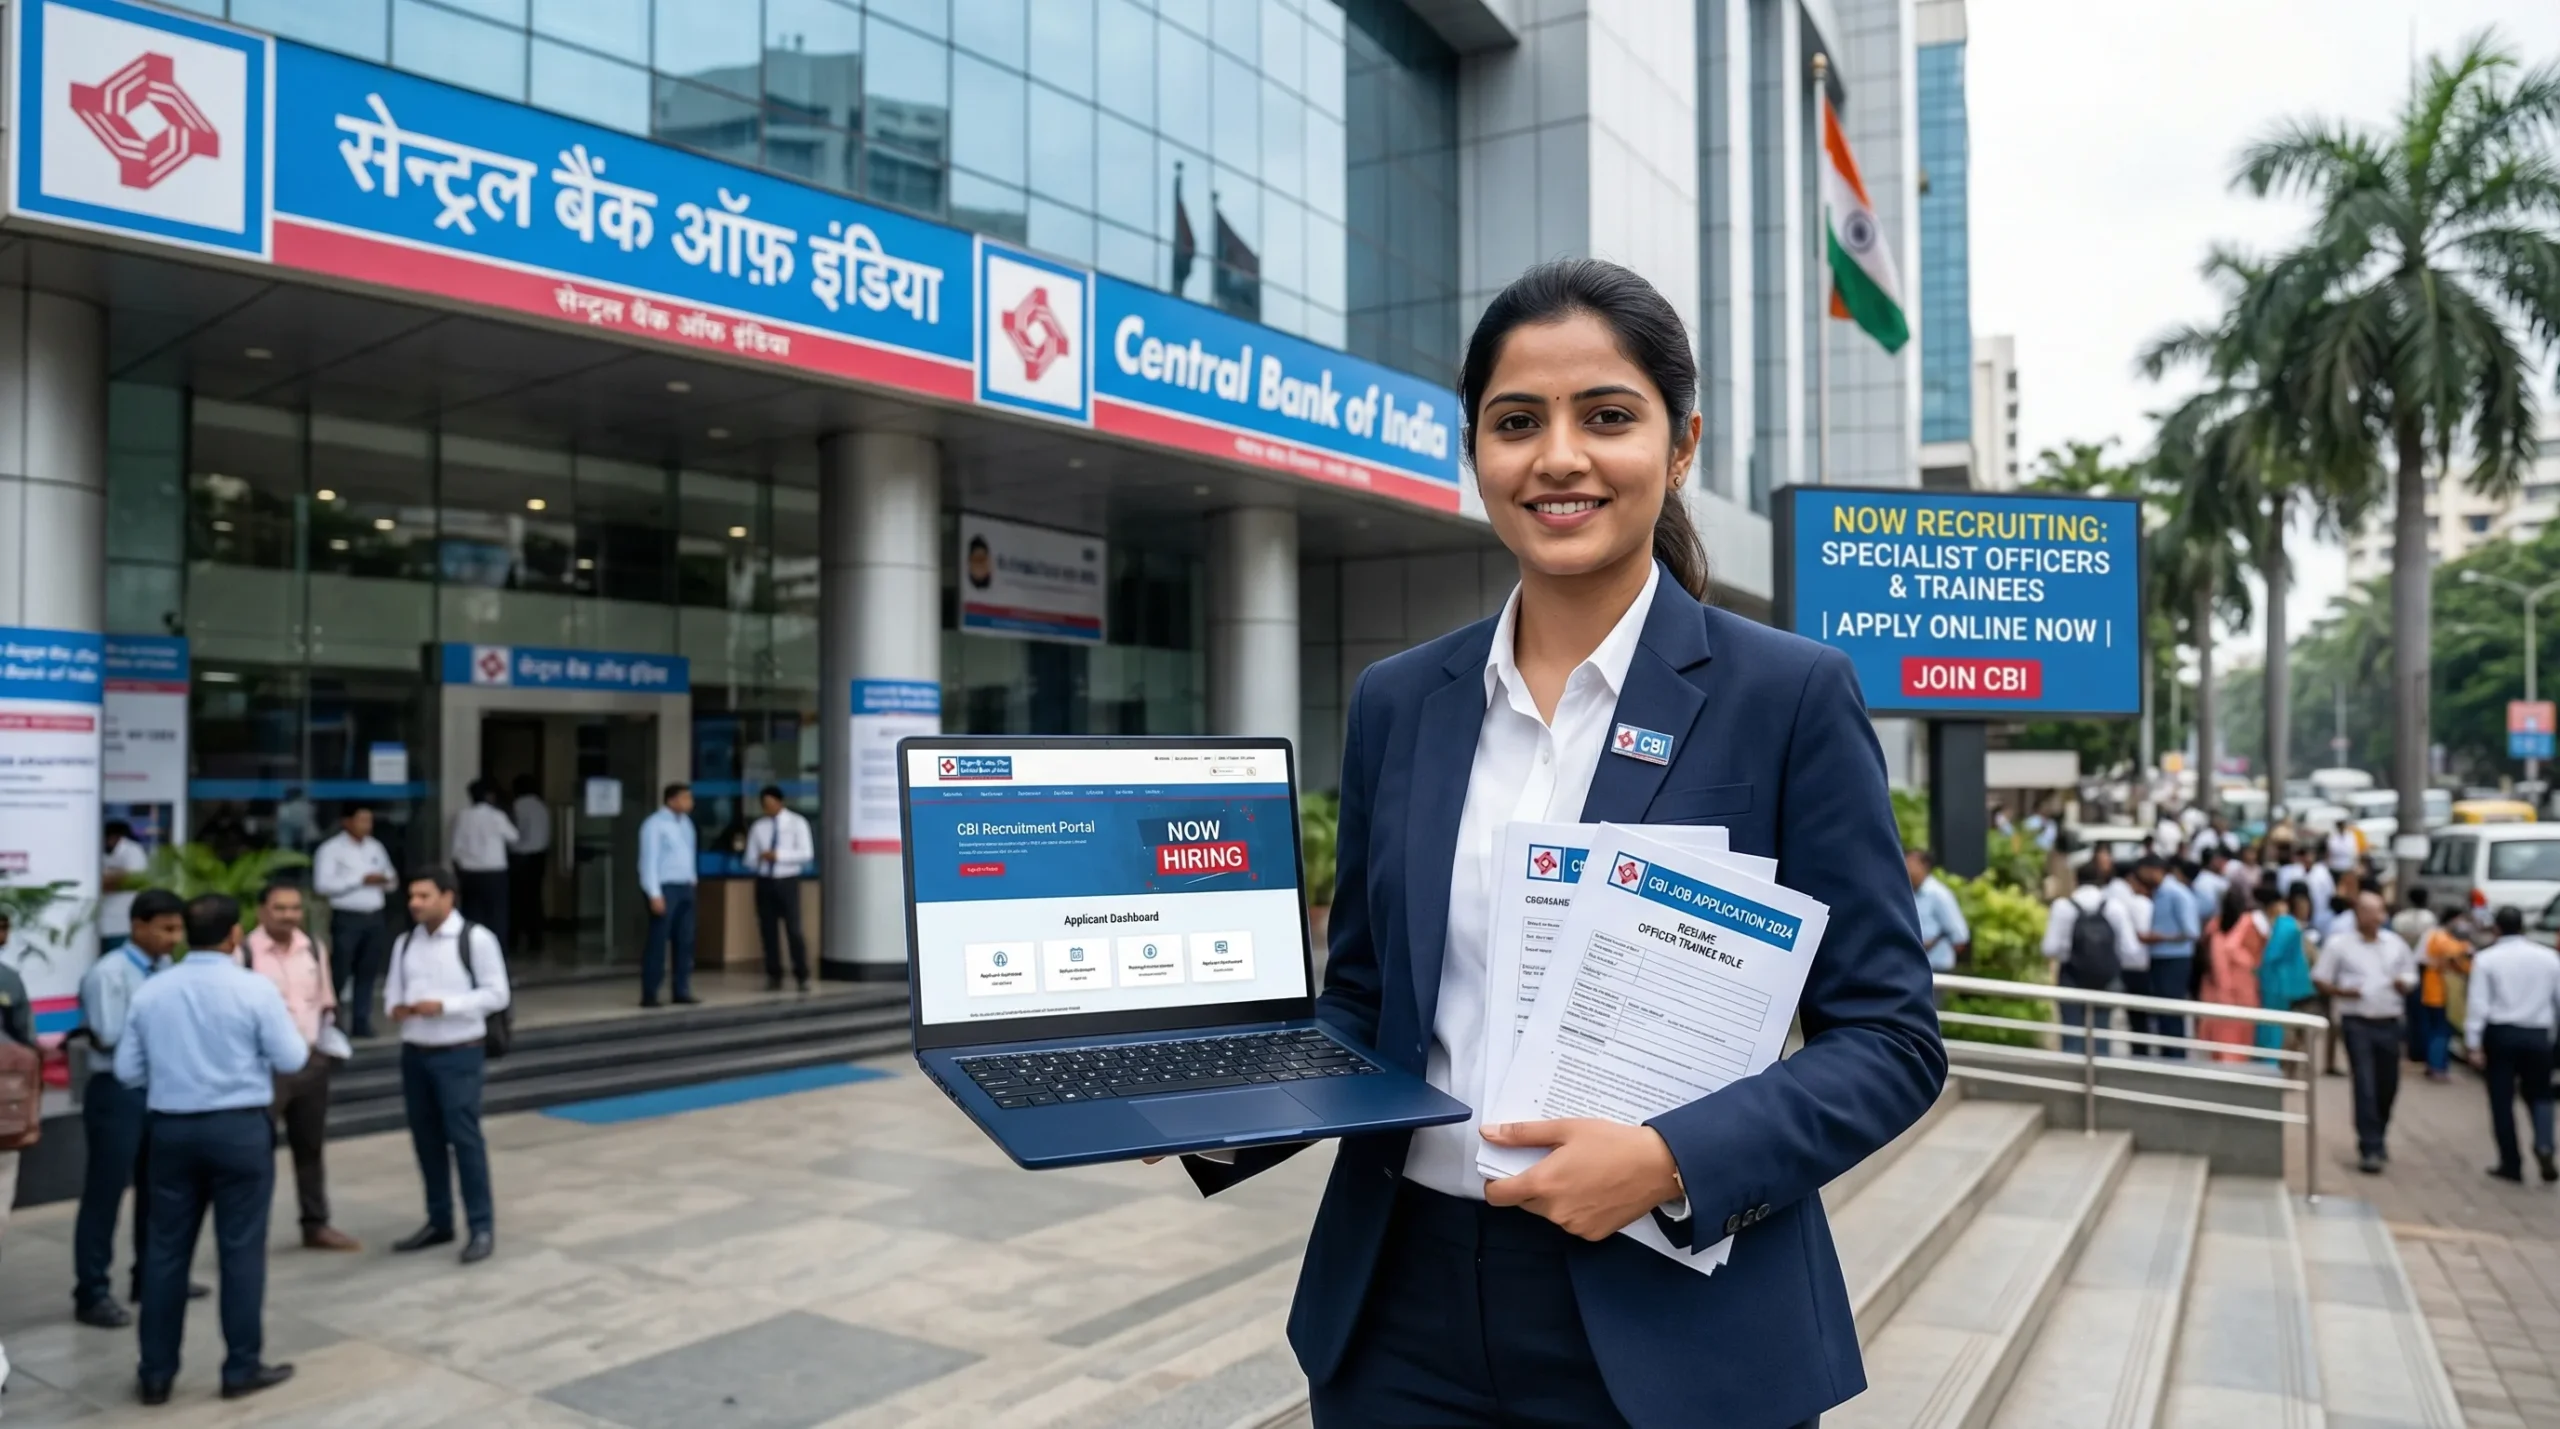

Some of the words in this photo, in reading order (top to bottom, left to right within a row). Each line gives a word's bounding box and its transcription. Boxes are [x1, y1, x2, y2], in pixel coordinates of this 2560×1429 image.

[335, 93, 537, 236] सेन्ट्रल
[550, 144, 659, 252] बैंक
[809, 220, 944, 324] इंडिया
[1114, 314, 1253, 404] Central
[1257, 354, 1342, 430] Bank
[1344, 383, 1379, 439] of
[1381, 392, 1448, 461] India
[1834, 505, 1908, 535] NOW
[1916, 508, 2109, 544] RECRUITING:
[1821, 541, 1979, 570] SPECIALIST
[1985, 546, 2111, 575] OFFICERS
[1888, 573, 1908, 599] &
[1914, 574, 2045, 603] TRAINEES
[1836, 612, 1922, 639] APPLY
[1929, 614, 2029, 641] ONLINE
[2035, 617, 2098, 643] NOW
[1912, 664, 1977, 691] JOIN
[1982, 665, 2027, 692] CBI
[1640, 736, 1666, 756] CBI
[957, 823, 979, 835] CBI
[982, 821, 1057, 835] Recruitment
[1059, 820, 1095, 834] Portal
[1167, 820, 1220, 842] NOW
[1163, 846, 1243, 870] HIRING
[1064, 913, 1108, 926] Applicant
[1110, 911, 1159, 924] Dashboard
[1668, 884, 1693, 902] JOB
[1692, 893, 1767, 930] APPLICATION
[1766, 919, 1794, 940] 2024
[1718, 952, 1744, 970] ROLE
